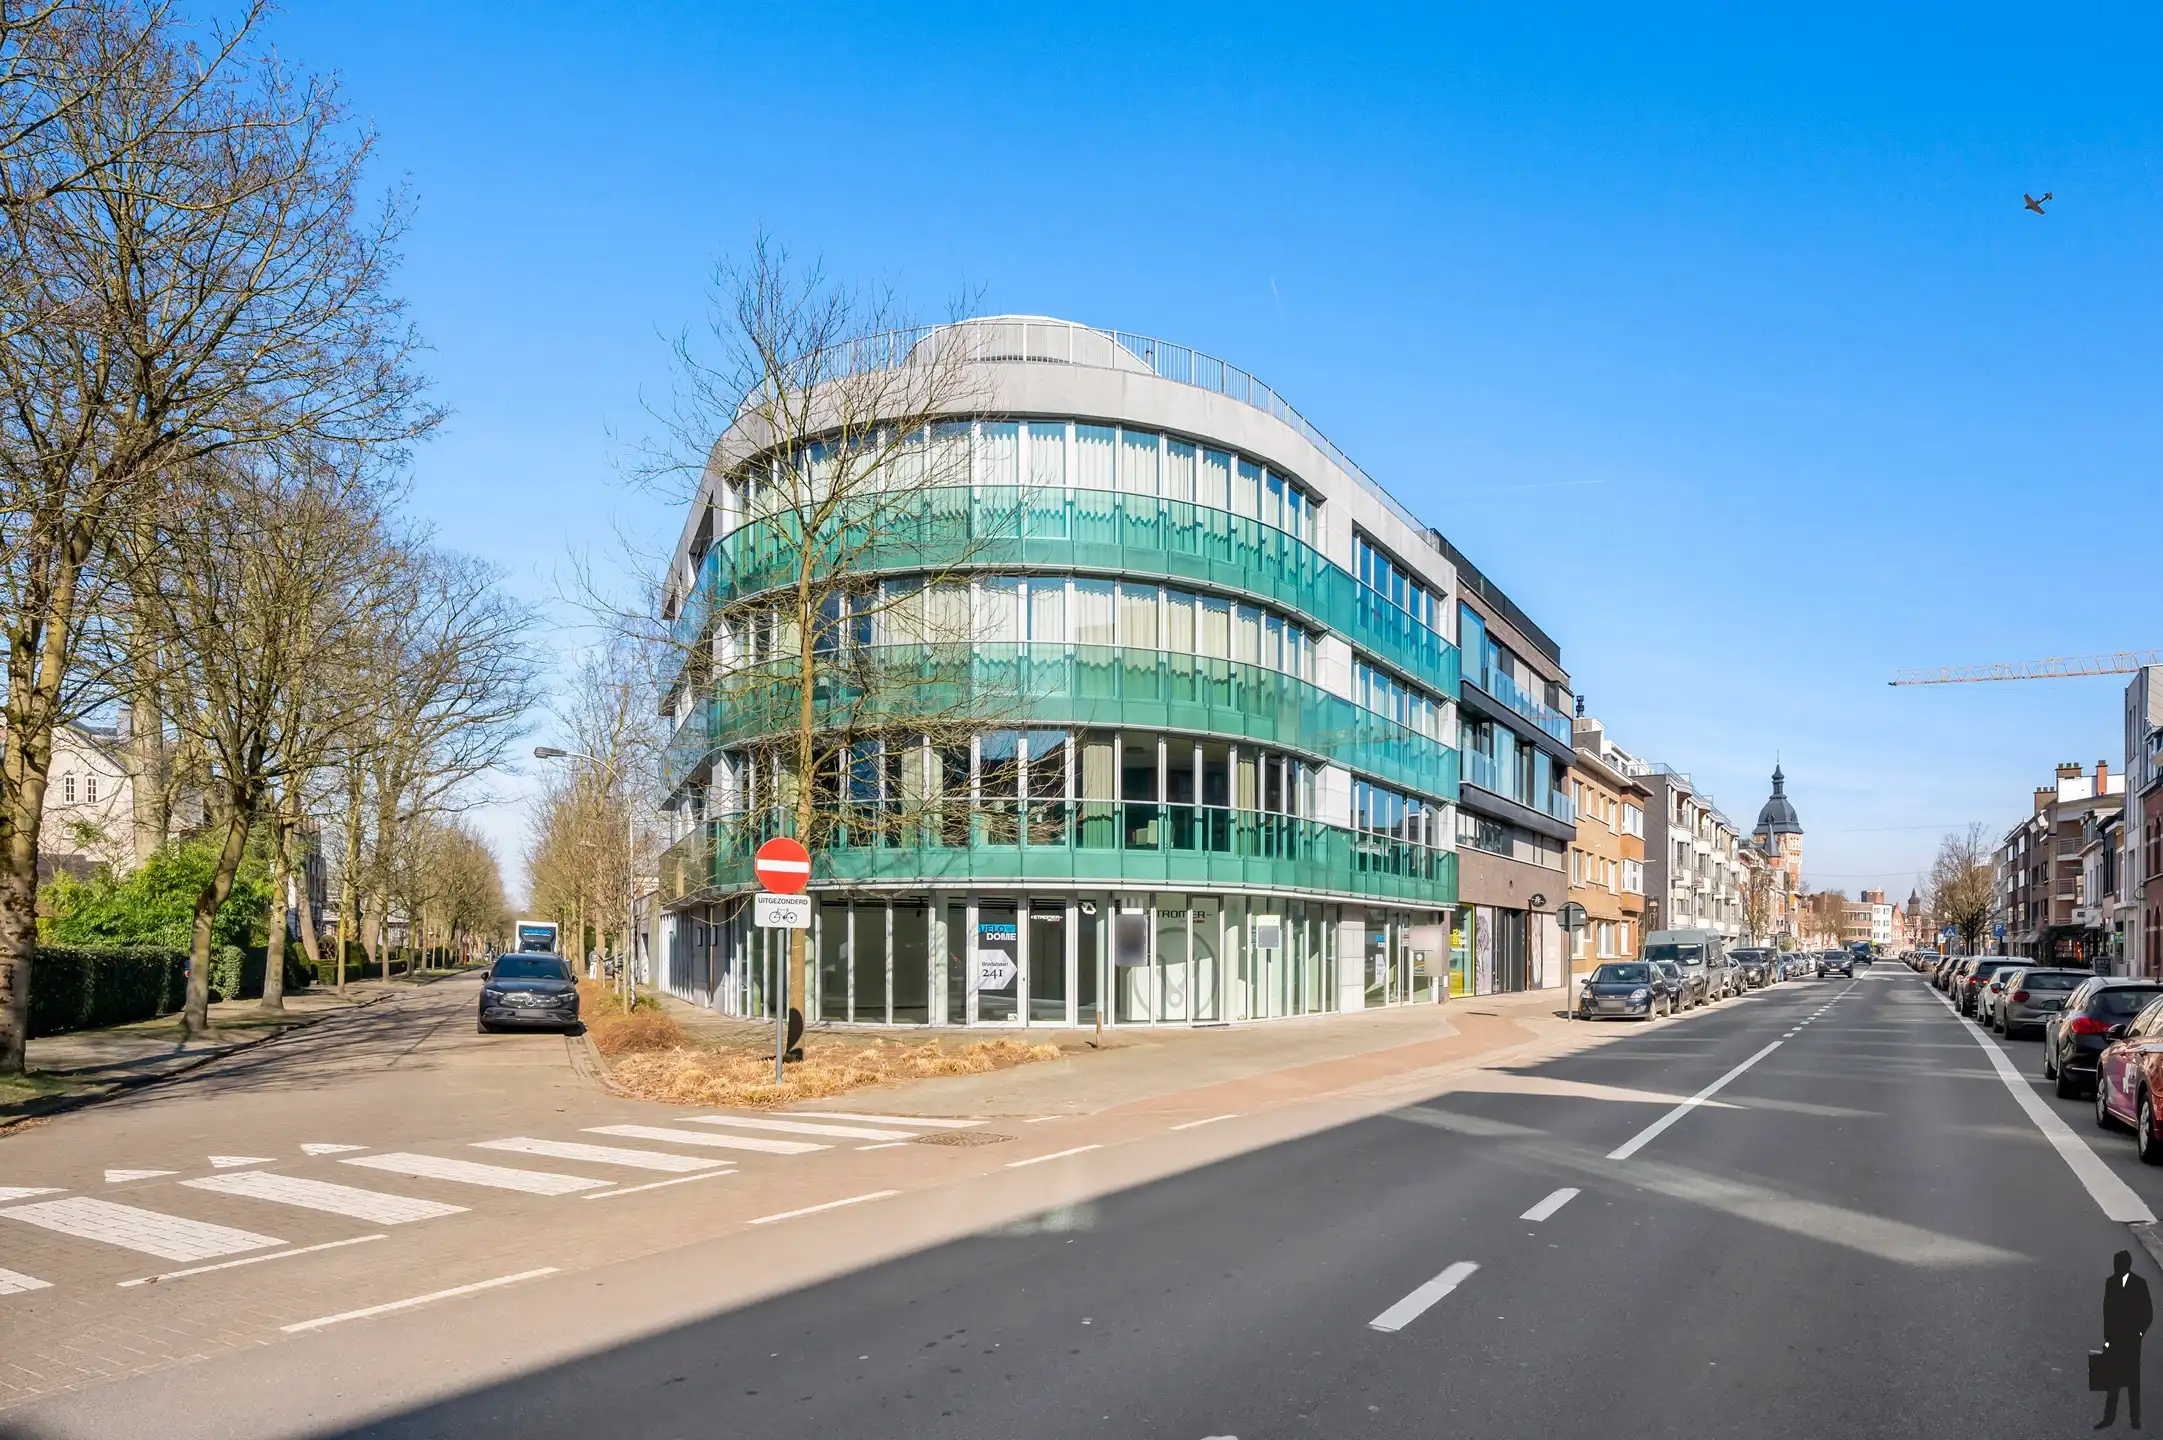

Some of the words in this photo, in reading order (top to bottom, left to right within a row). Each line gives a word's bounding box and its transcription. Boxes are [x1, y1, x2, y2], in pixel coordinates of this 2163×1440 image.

[758, 897, 808, 905] UITGEZONDERD
[978, 925, 1005, 933] VELO
[1996, 924, 2002, 932] P
[986, 932, 1017, 941] DOME
[982, 969, 1003, 980] 241
